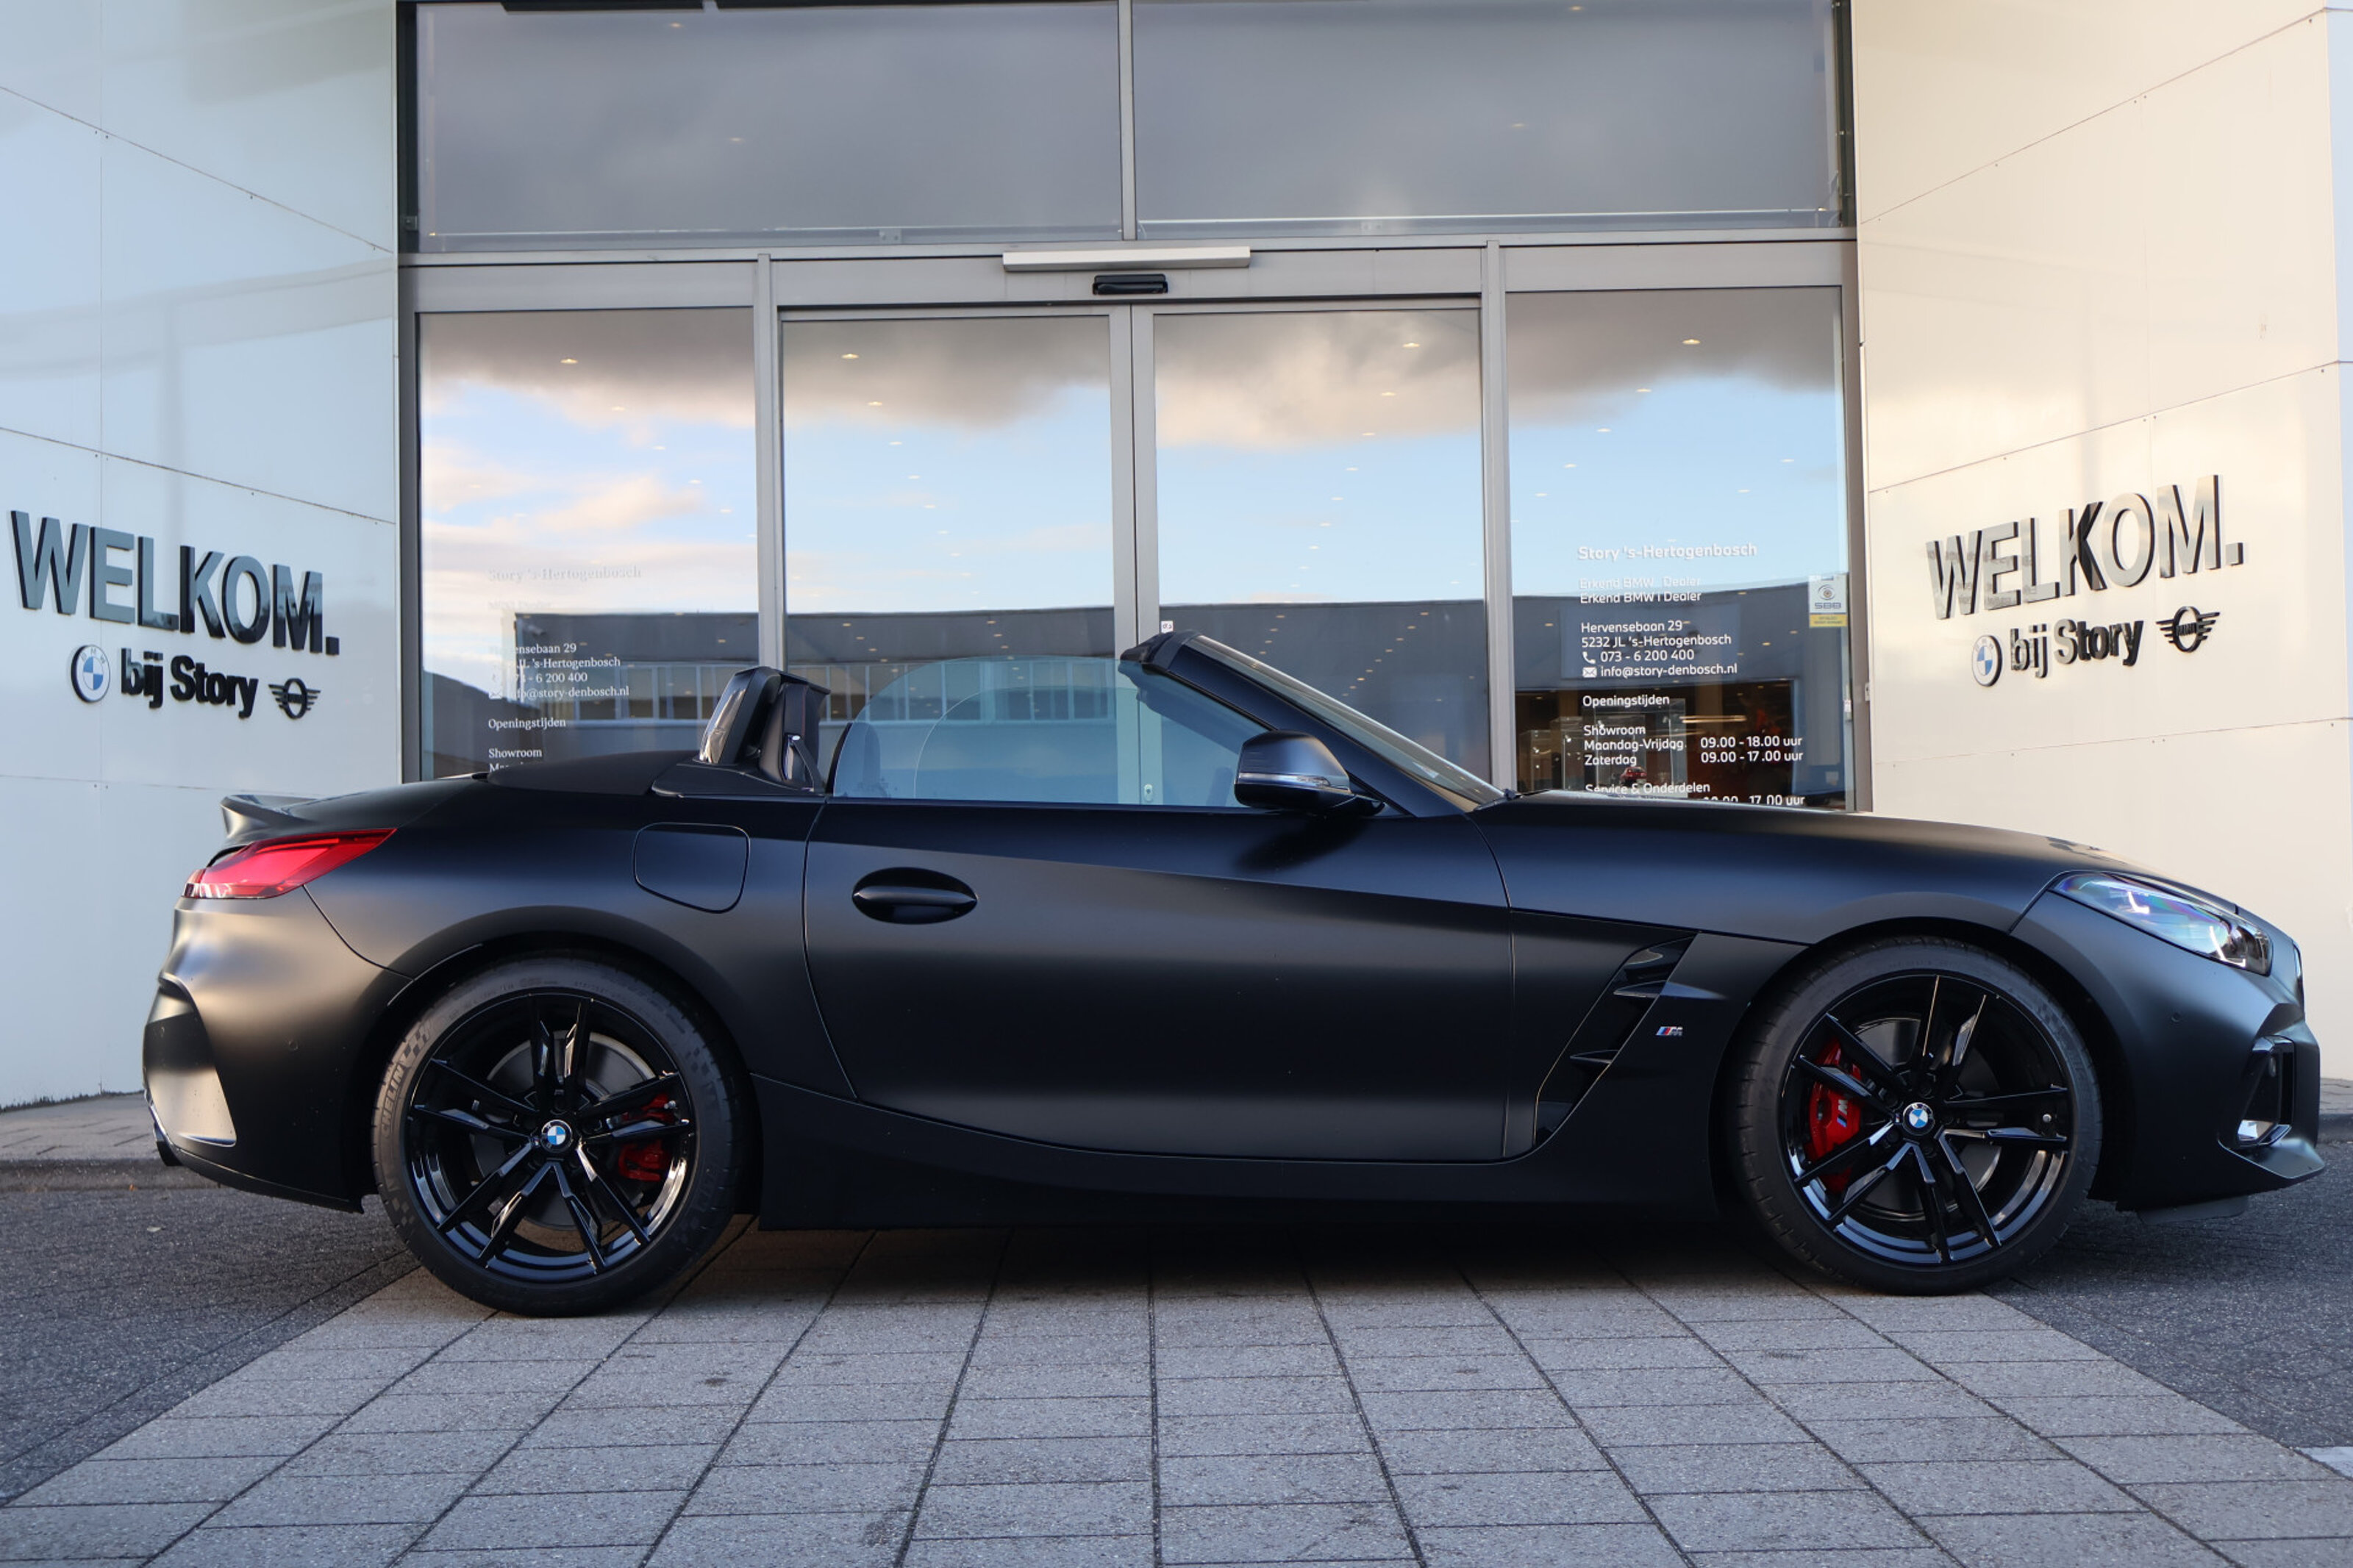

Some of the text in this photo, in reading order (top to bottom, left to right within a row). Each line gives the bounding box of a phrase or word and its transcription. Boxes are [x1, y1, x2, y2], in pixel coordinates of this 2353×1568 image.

[1579, 543, 1757, 561] Story 's-Hertogenbosch
[1926, 474, 2244, 620] WELKOM.
[10, 510, 340, 656] WELKOM.
[1579, 575, 1702, 589] Erkend BMW Dealer
[1580, 592, 1621, 604] Erkend
[1624, 592, 1654, 603] BMW
[1663, 590, 1702, 601] Dealer
[1581, 620, 1682, 634] Hervensebaan 29
[563, 642, 576, 653] 29
[1581, 634, 1732, 648] 5232 JL 's-Hertogenbosch
[1600, 651, 1622, 662] 073
[1633, 650, 1641, 662] 6
[1644, 650, 1668, 661] 200
[1671, 649, 1695, 660] 400
[2010, 619, 2143, 678] bij Story
[532, 656, 621, 670] 's-Hertogenbosch
[536, 673, 543, 683] 6
[546, 672, 565, 683] 200
[568, 672, 588, 682] 400
[1601, 662, 1738, 679] info@story-denbosch.nl
[121, 648, 258, 718] bij Story
[1582, 694, 1670, 709] Openingstijden
[488, 717, 566, 732] Openingstijden
[1583, 724, 1646, 736] Showroom
[1584, 738, 1684, 752] Maandag-Vrijdag
[1700, 737, 1736, 748] 09.00
[1746, 735, 1780, 748] 18.00
[1783, 737, 1803, 747] uur
[488, 748, 543, 758] Showroom
[1584, 753, 1638, 767] Zaterdag
[1701, 751, 1736, 763] 09.00
[1784, 752, 1804, 762] uur
[1631, 783, 1640, 795] &
[1643, 781, 1710, 794] Onderdelen
[1785, 796, 1805, 806] uur
